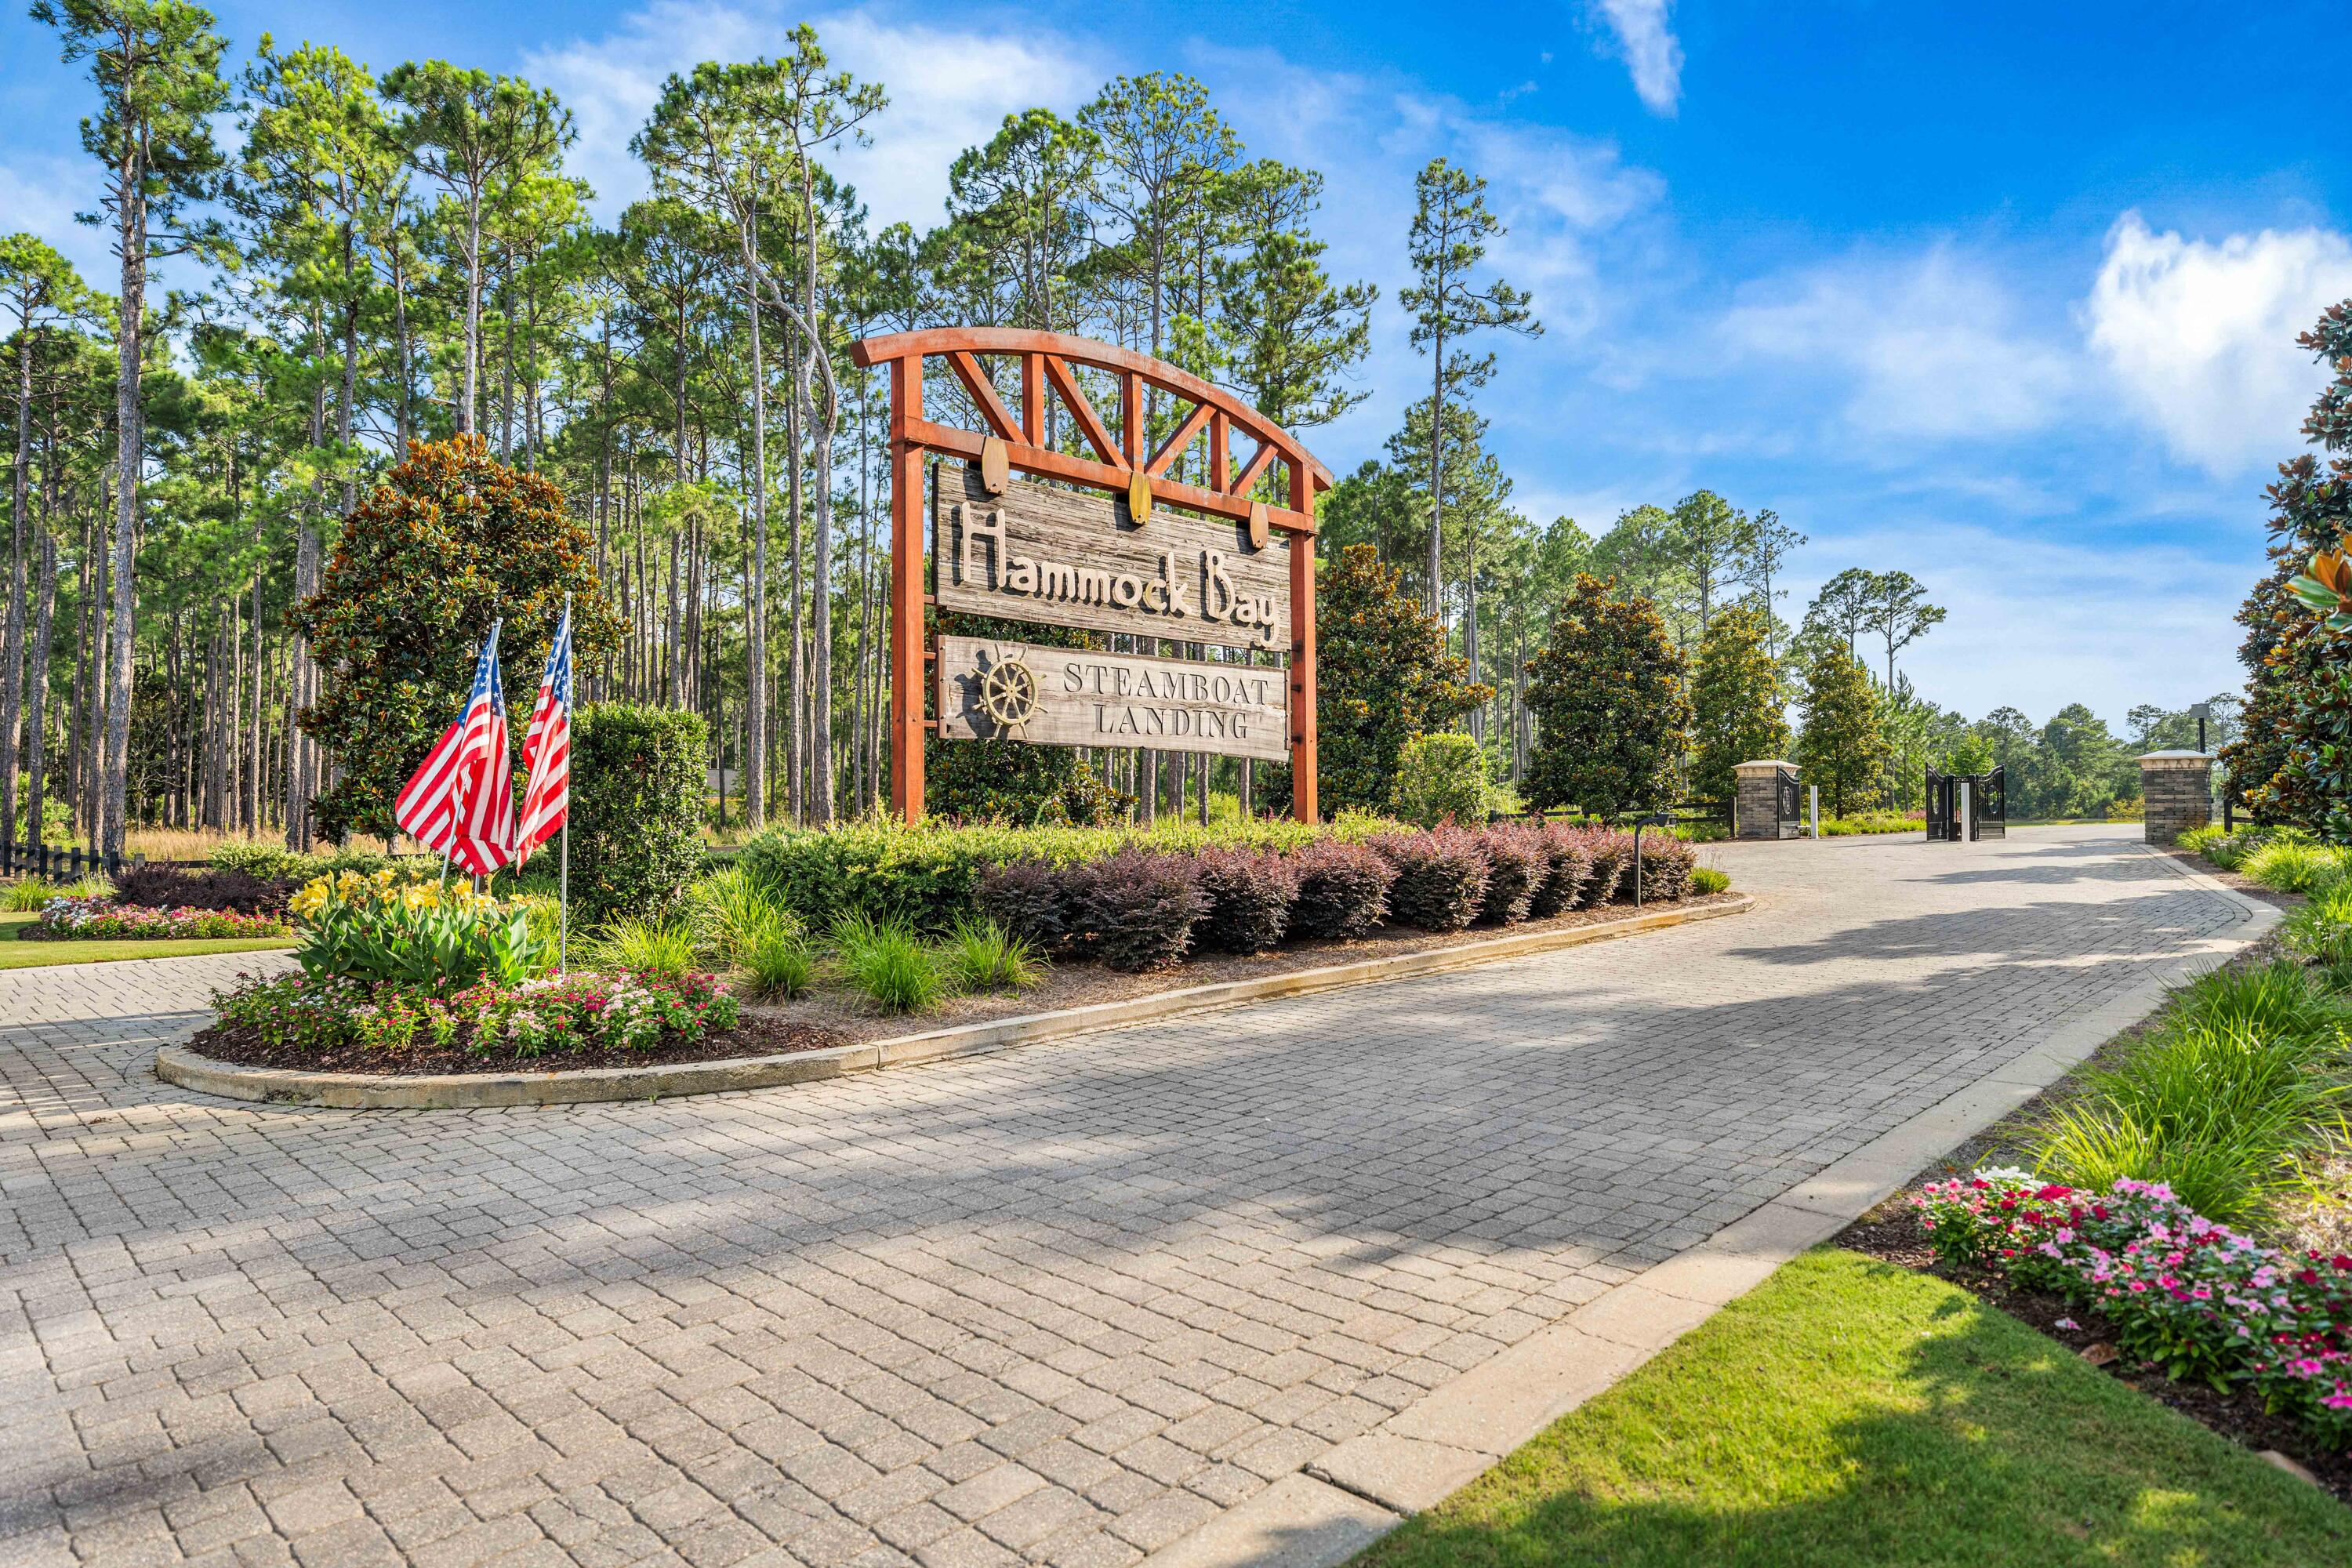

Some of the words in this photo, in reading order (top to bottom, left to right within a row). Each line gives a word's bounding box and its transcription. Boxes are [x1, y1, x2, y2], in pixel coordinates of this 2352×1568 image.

[961, 501, 1192, 614] Hammock
[1206, 548, 1280, 648] Bay
[1063, 662, 1269, 706] STEAMBOAT
[1093, 703, 1248, 739] LANDING
